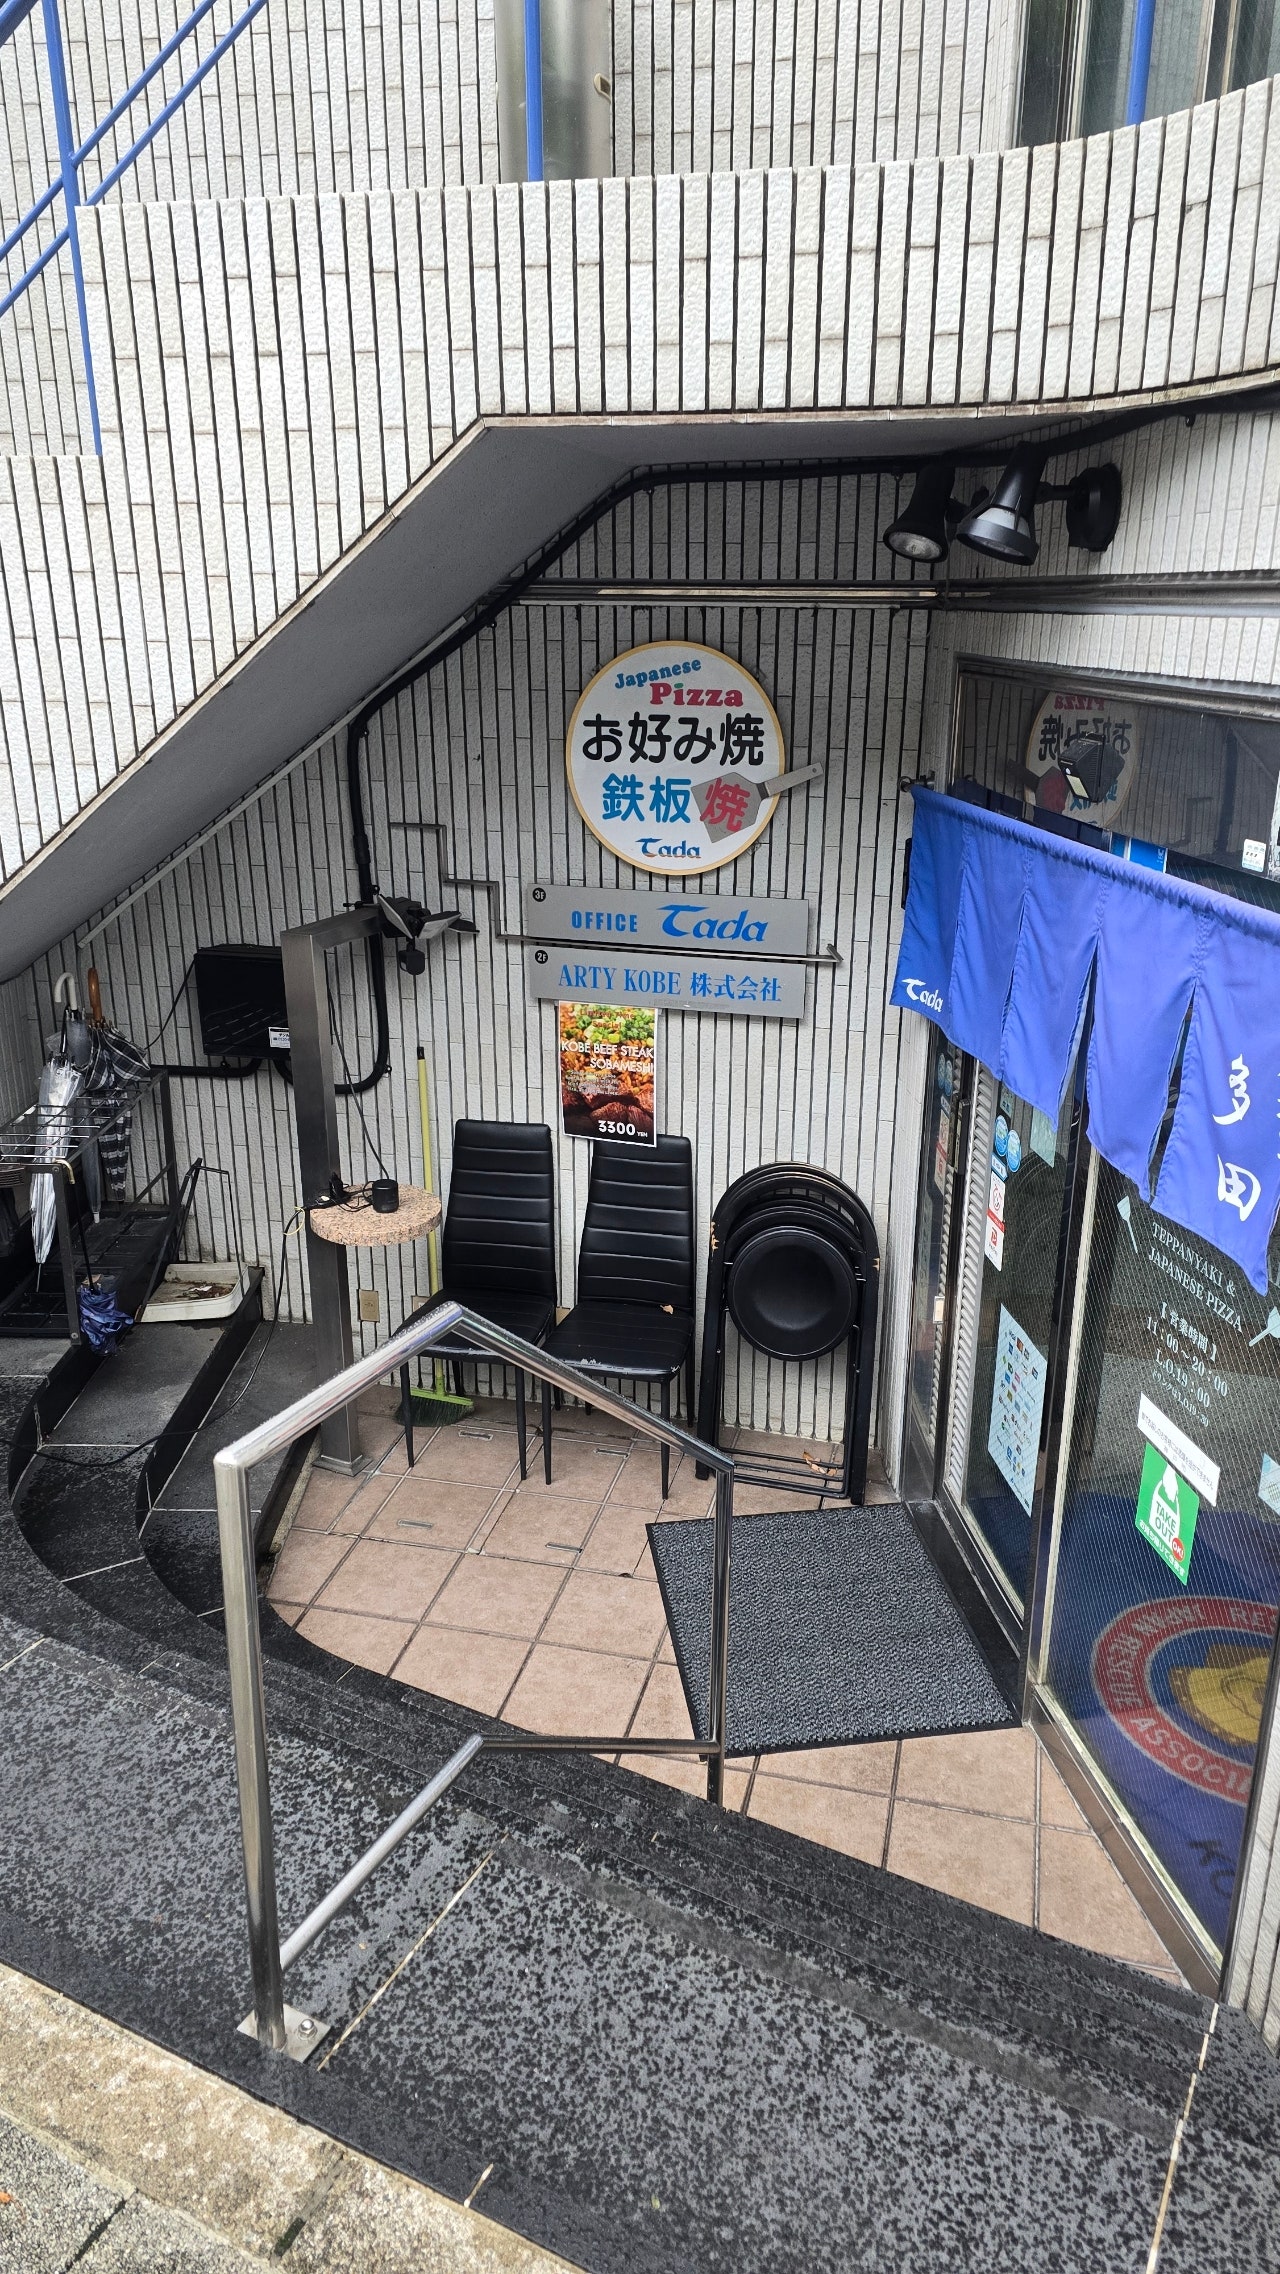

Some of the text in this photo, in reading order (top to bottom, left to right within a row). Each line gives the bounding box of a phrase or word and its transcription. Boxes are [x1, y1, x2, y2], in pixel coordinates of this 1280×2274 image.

[614, 659, 702, 689] Japanese
[650, 682, 744, 707] Pizza
[582, 711, 765, 766] お好み焼
[635, 837, 702, 859] Tada
[535, 889, 545, 900] 3F
[571, 904, 768, 942] OFFICE Tada
[537, 952, 547, 962] 2F
[558, 964, 782, 1002] ARTY KOBE 株式会社
[901, 978, 943, 1012] Tada
[561, 1041, 655, 1059] KOBE BEEF STEAK
[590, 1058, 654, 1074] SOBAMESHI
[598, 1120, 636, 1136] 3300
[1152, 1221, 1236, 1298] TEPPANYAKI &
[1148, 1246, 1243, 1333] JAPANESE PIZZA
[1155, 1516, 1174, 1543] OUT
[1156, 1501, 1176, 1533] TAKE
